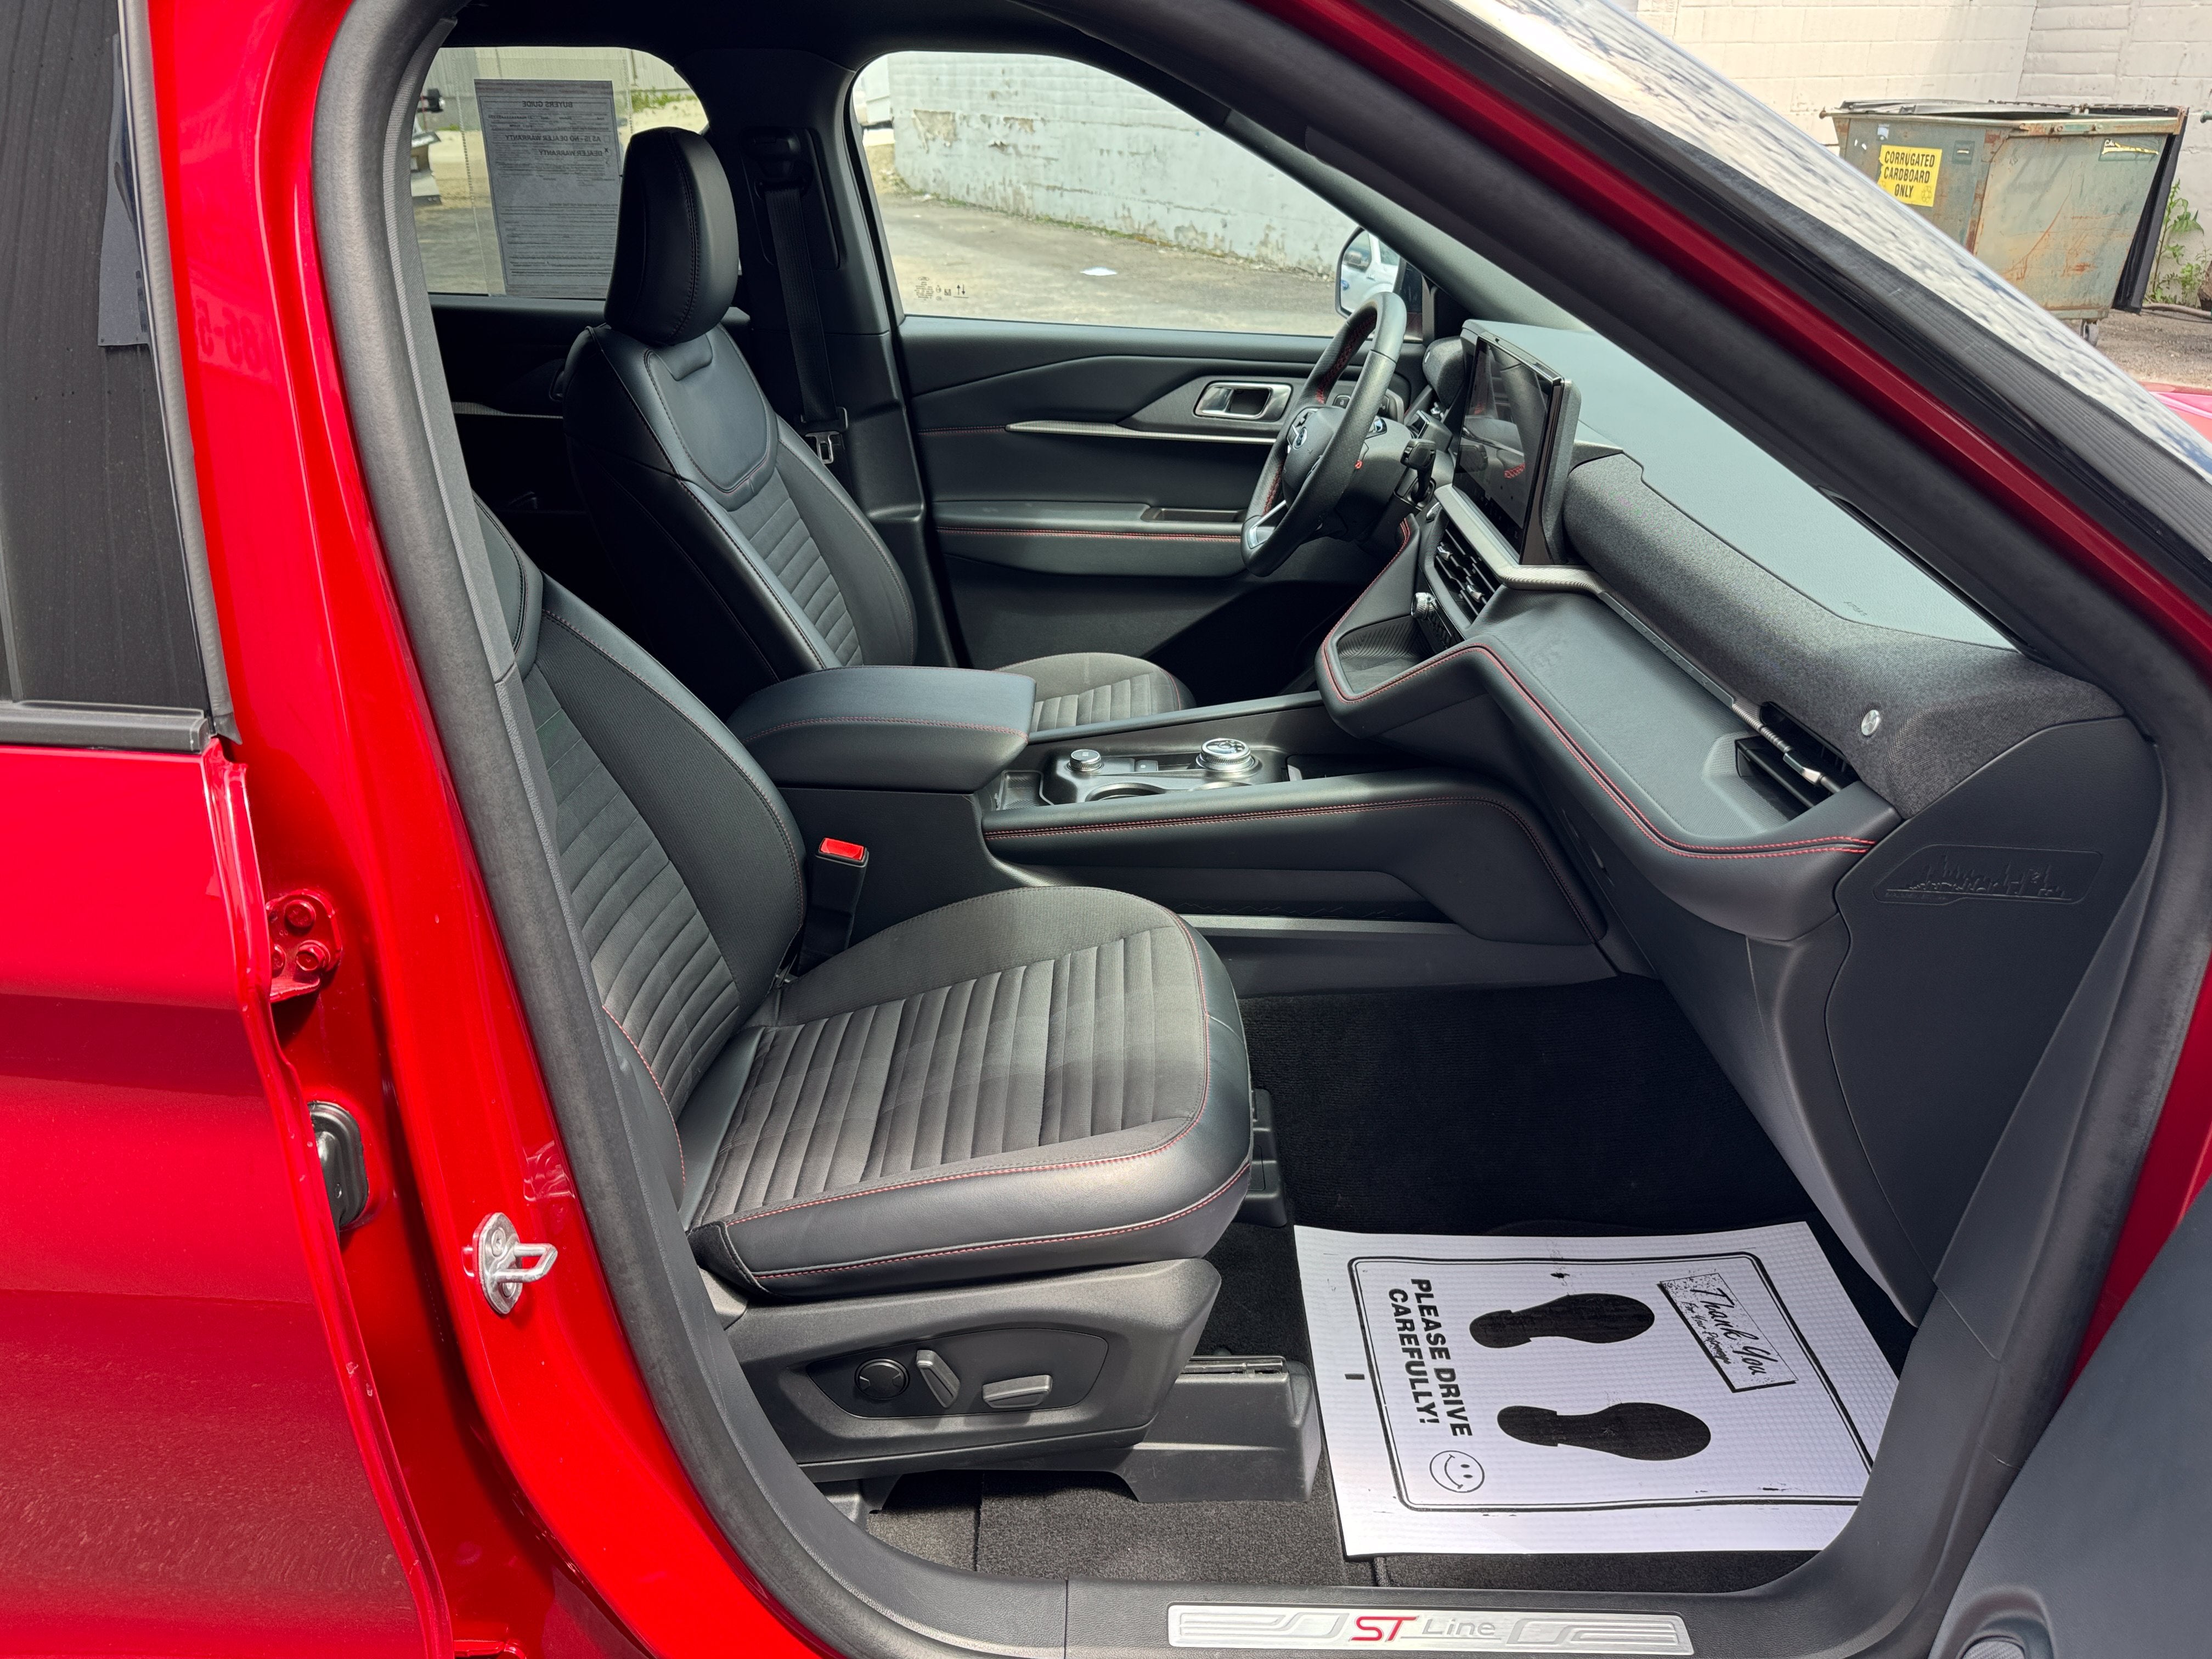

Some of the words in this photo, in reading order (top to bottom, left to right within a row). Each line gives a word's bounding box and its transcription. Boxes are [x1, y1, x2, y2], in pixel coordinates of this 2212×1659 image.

[1884, 151, 1936, 168] CORRUGATED
[1883, 166, 1931, 184] CARDBOARD
[1894, 183, 1914, 198] ONLY
[1690, 1288, 1759, 1340] Thank
[1733, 1346, 1779, 1375] You
[1389, 1288, 1440, 1424] CAREFULLY!
[1410, 1279, 1451, 1360] PLEASE
[1434, 1368, 1473, 1436] DRIVE
[1348, 1616, 1420, 1642] ST
[1422, 1618, 1496, 1636] Line
